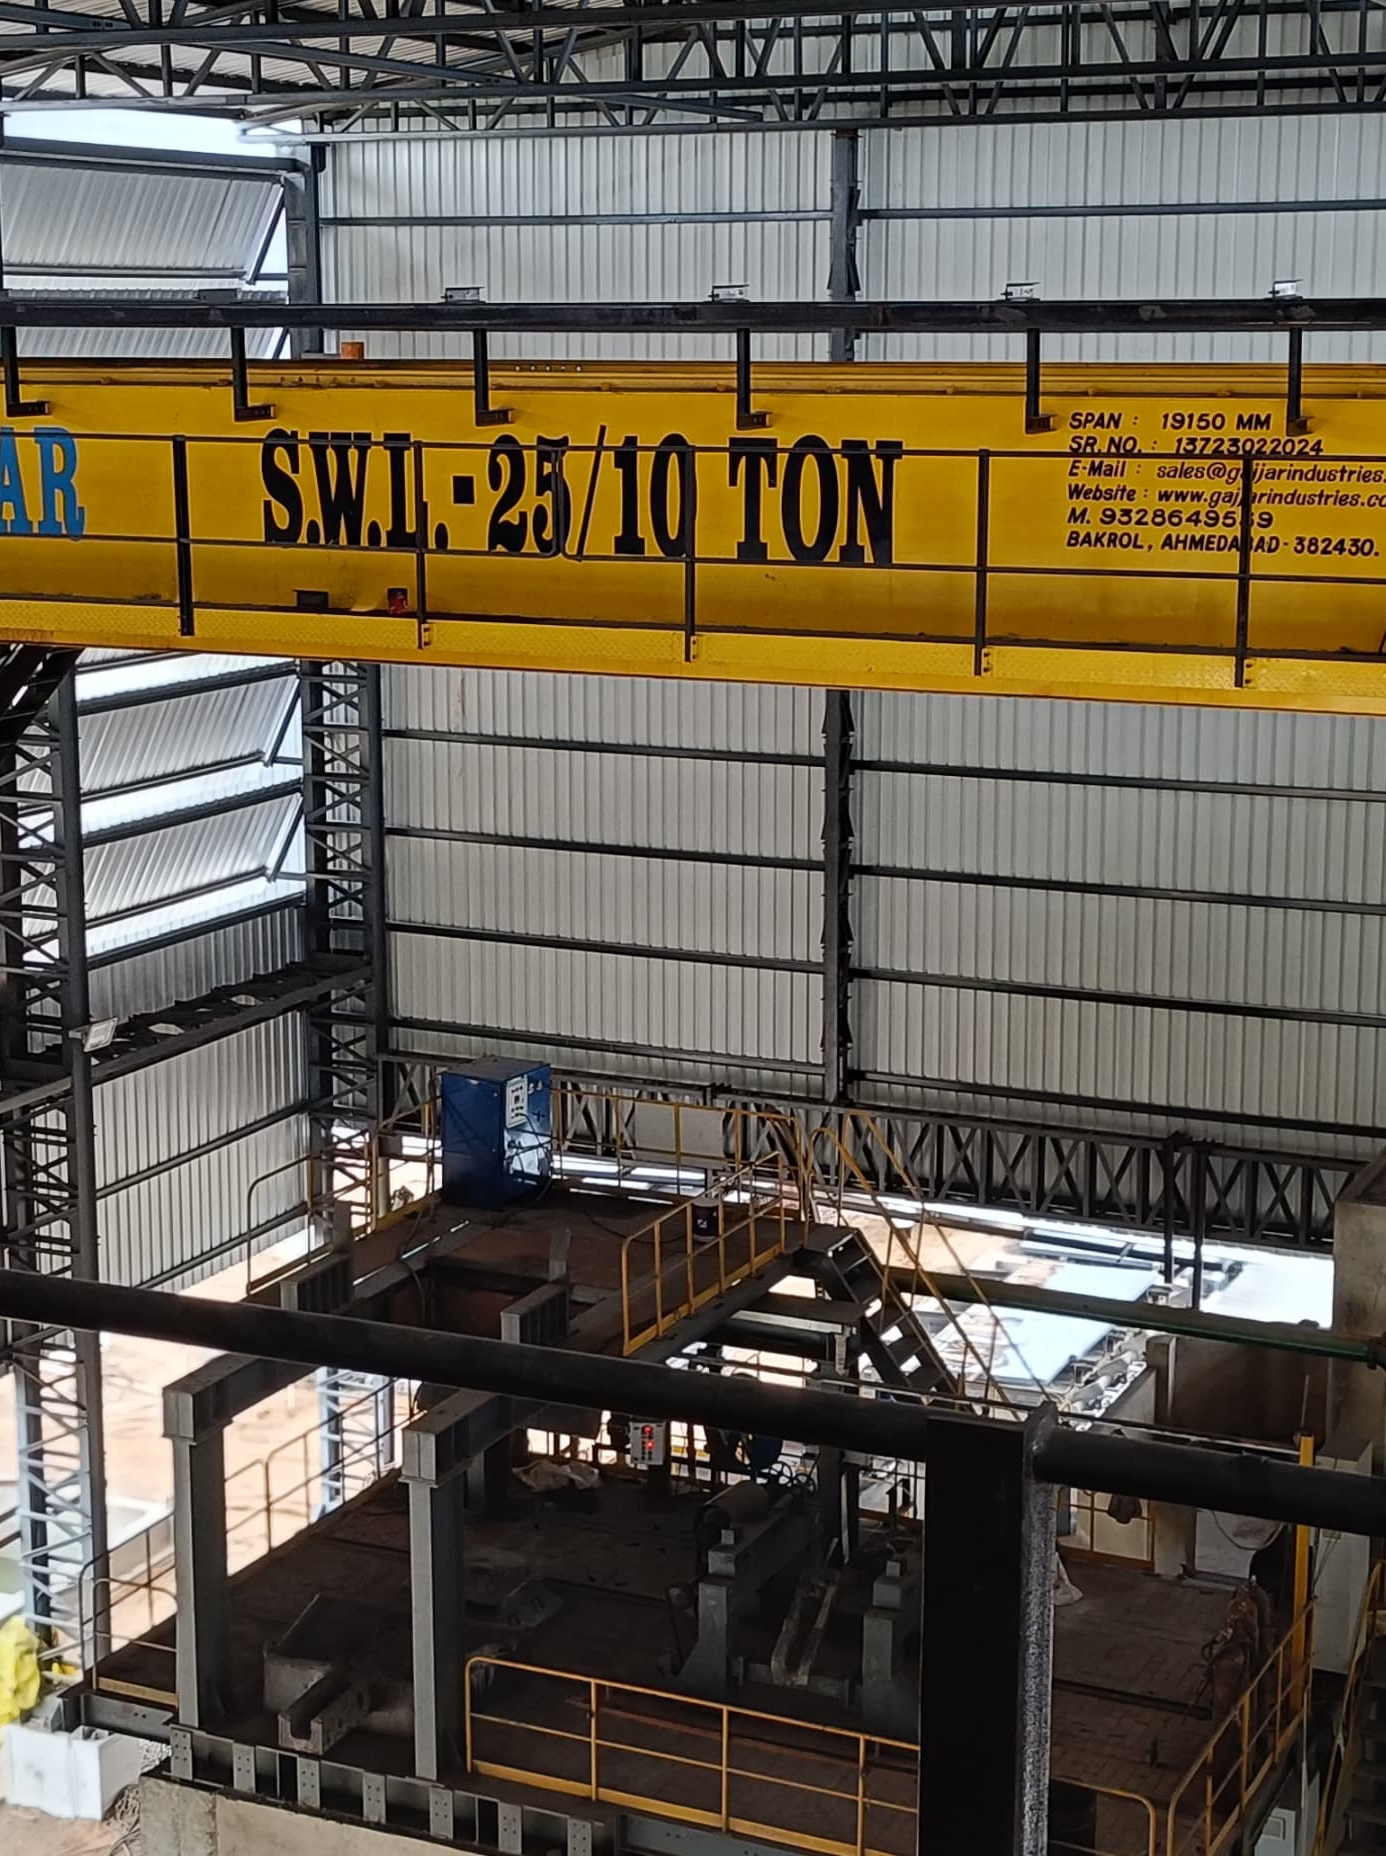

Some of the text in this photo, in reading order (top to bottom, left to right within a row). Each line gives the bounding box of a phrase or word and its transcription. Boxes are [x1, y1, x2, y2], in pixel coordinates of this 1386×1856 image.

[1162, 412, 1226, 431] 19150
[1235, 413, 1272, 431] MM
[1175, 437, 1324, 456] 13723022024
[1068, 459, 1127, 477] E-Mail
[729, 434, 904, 564] TON
[1068, 484, 1137, 501] Website
[1067, 507, 1092, 525] M.
